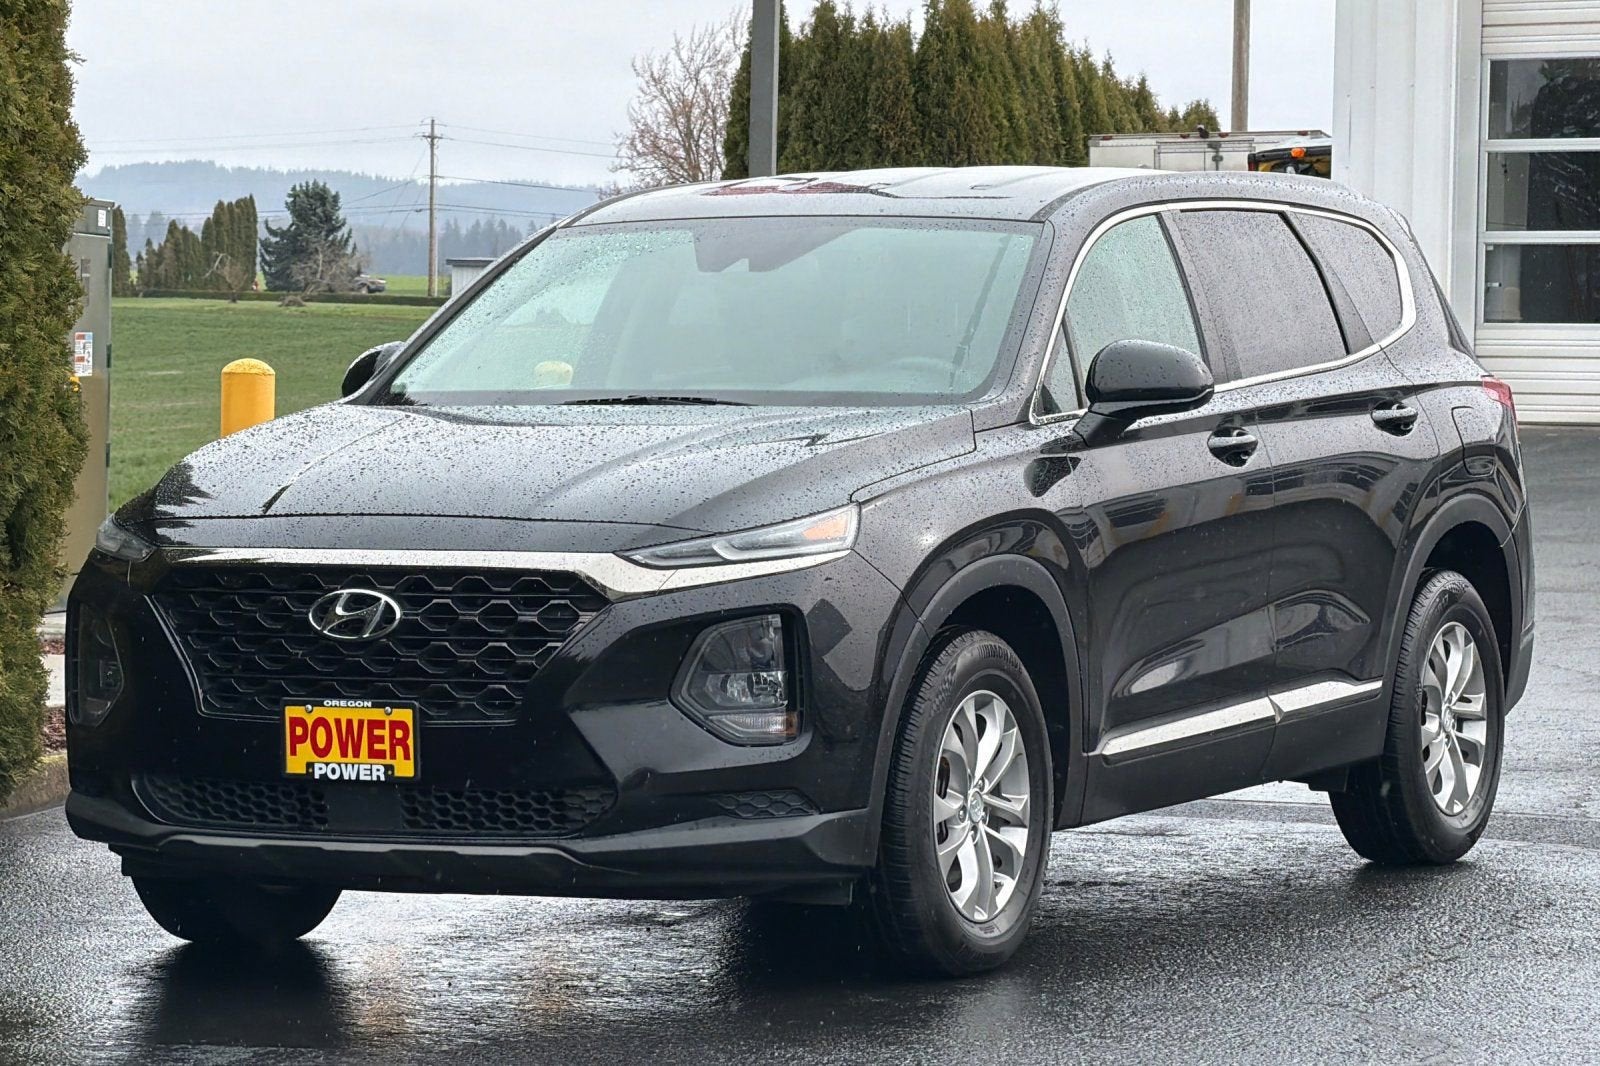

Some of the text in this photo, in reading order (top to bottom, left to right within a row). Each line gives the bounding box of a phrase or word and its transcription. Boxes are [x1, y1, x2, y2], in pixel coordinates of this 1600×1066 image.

[323, 700, 372, 708] OREGON
[288, 716, 411, 760] POWER
[314, 763, 385, 781] POWER
